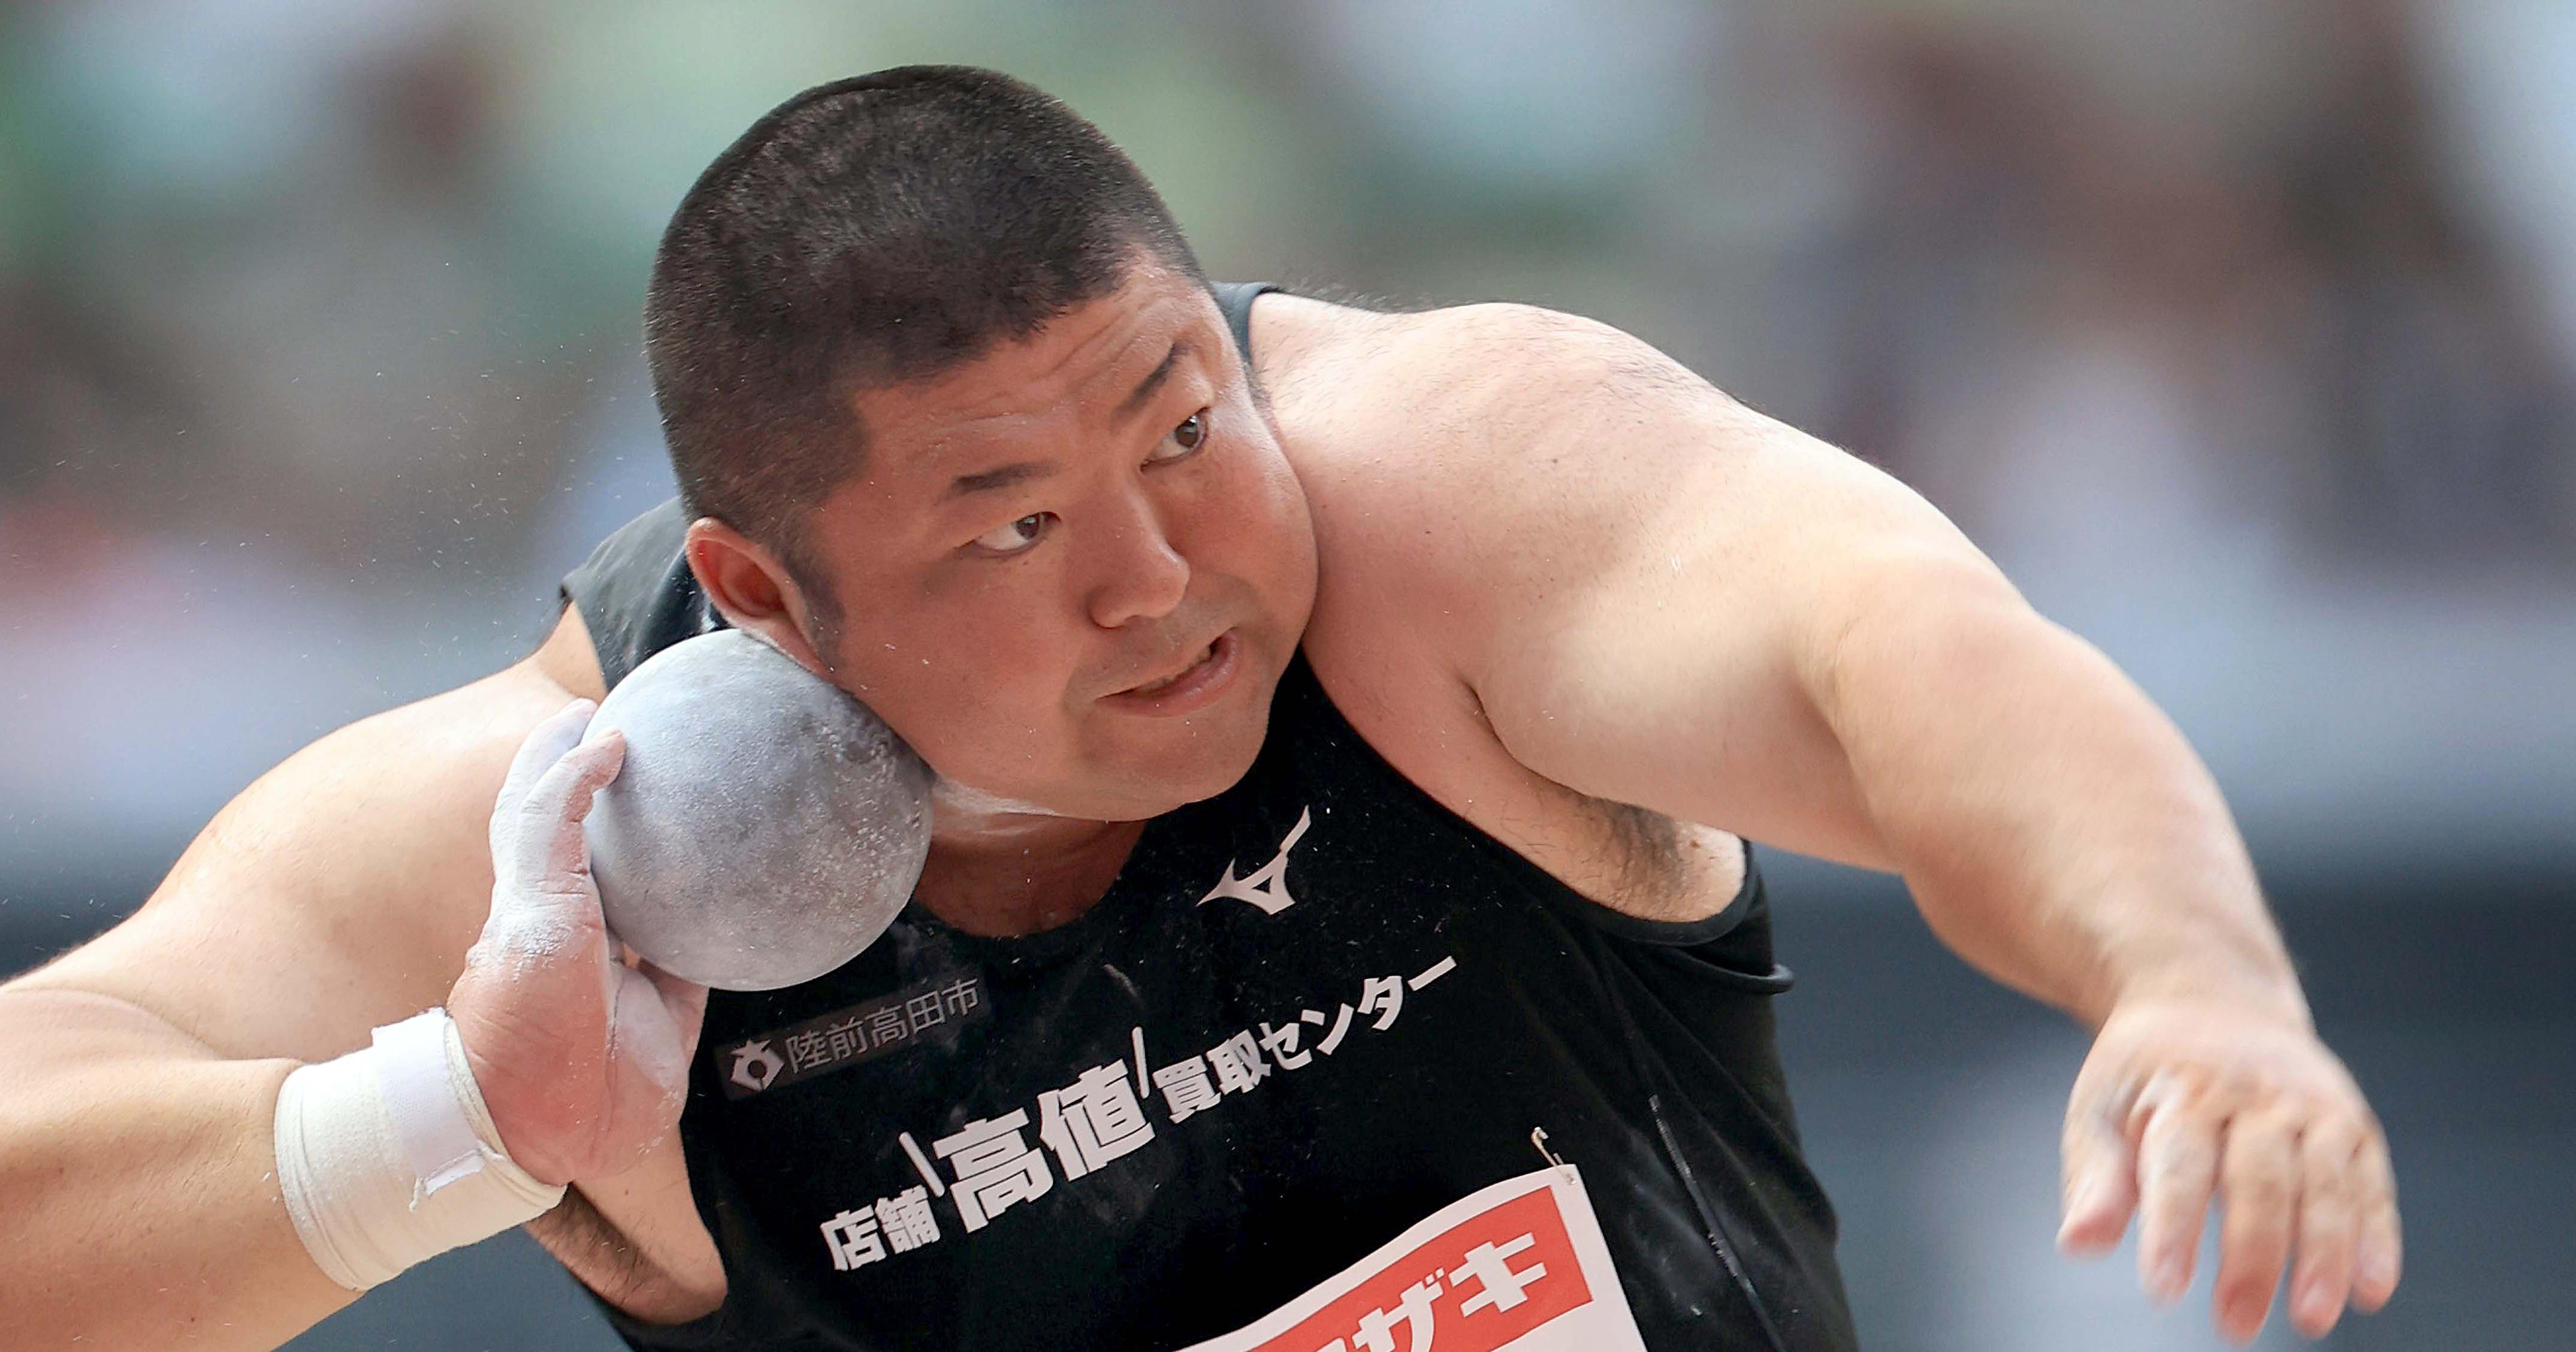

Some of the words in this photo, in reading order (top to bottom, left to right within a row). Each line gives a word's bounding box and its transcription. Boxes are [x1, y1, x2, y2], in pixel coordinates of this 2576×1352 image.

[785, 978, 980, 1074] 陸前高田市
[1316, 1232, 1547, 1352] ザキ
